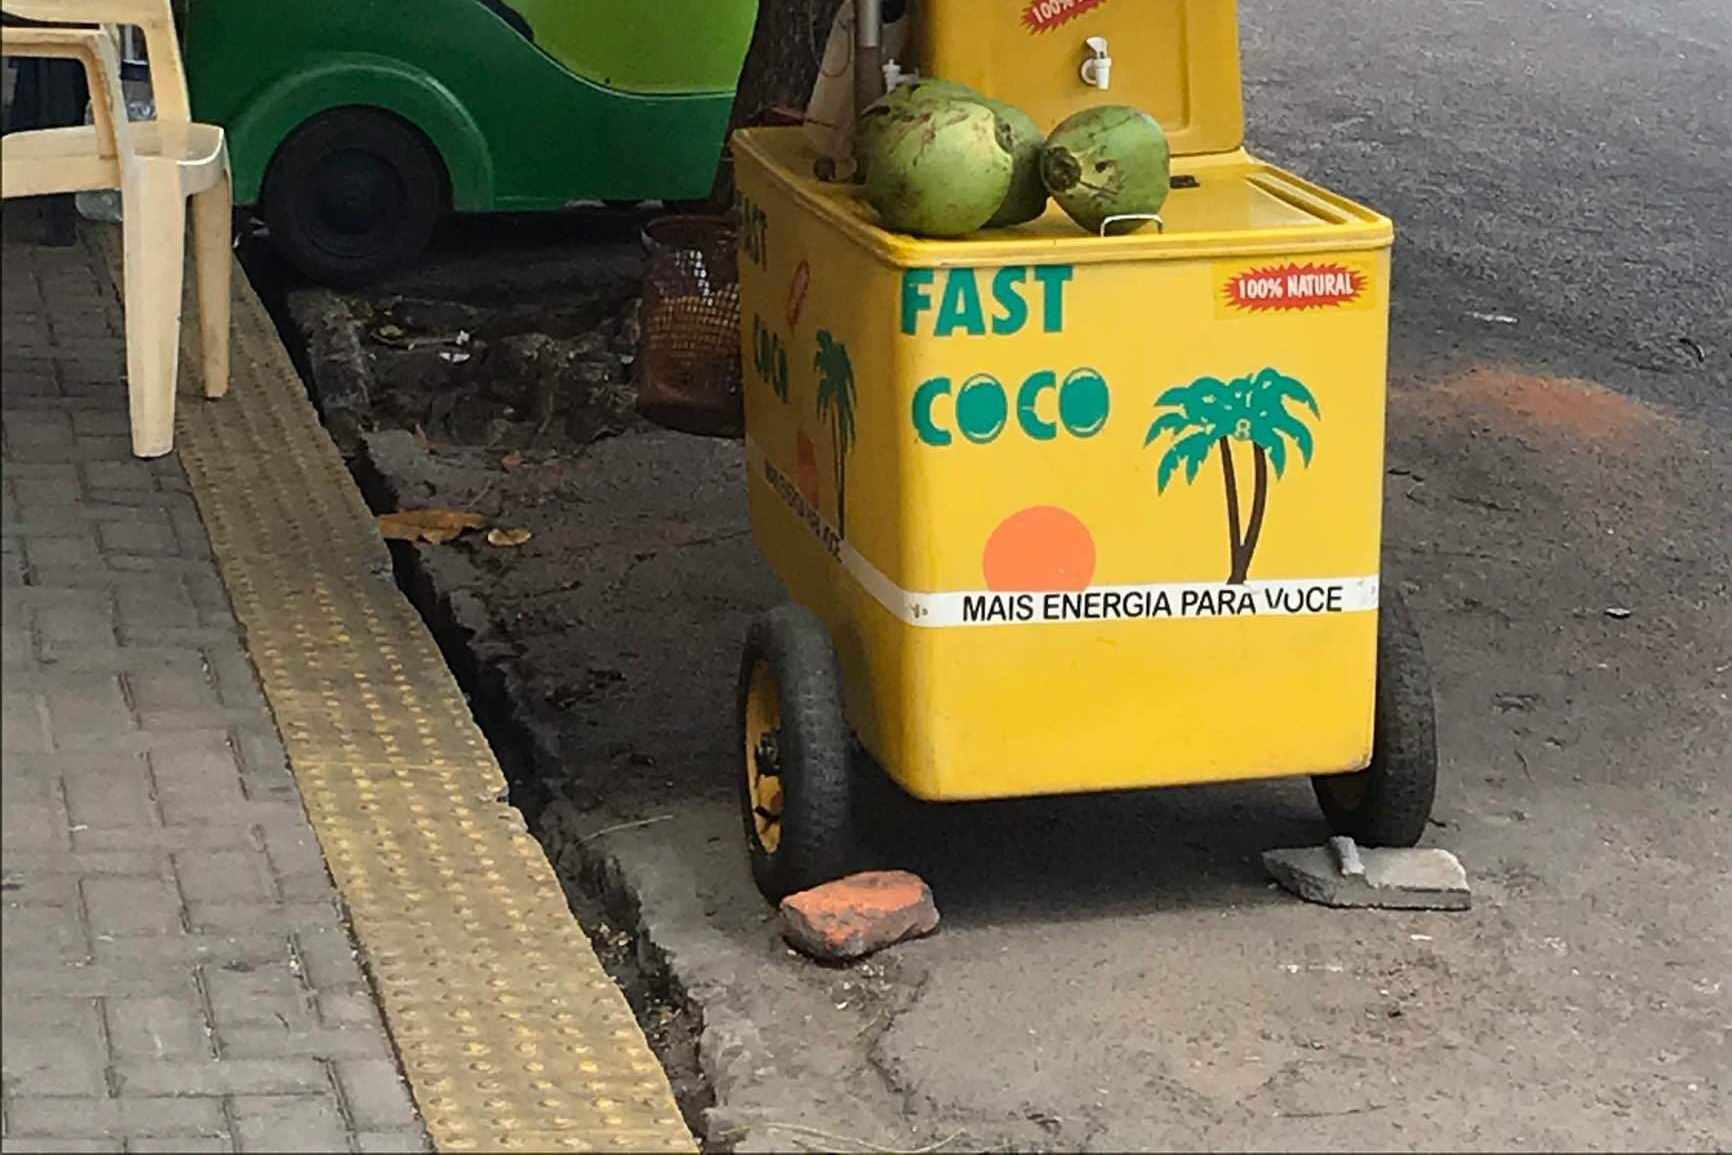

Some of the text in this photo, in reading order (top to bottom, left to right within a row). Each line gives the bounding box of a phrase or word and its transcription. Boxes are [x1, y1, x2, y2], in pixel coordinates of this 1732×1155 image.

[901, 265, 1073, 336] FAST
[1239, 272, 1354, 299] 100% NATURAL
[912, 367, 1110, 446] COCO
[962, 594, 1034, 622] MAIS
[1043, 591, 1172, 620] ENERGIA
[1181, 589, 1256, 616] PARA
